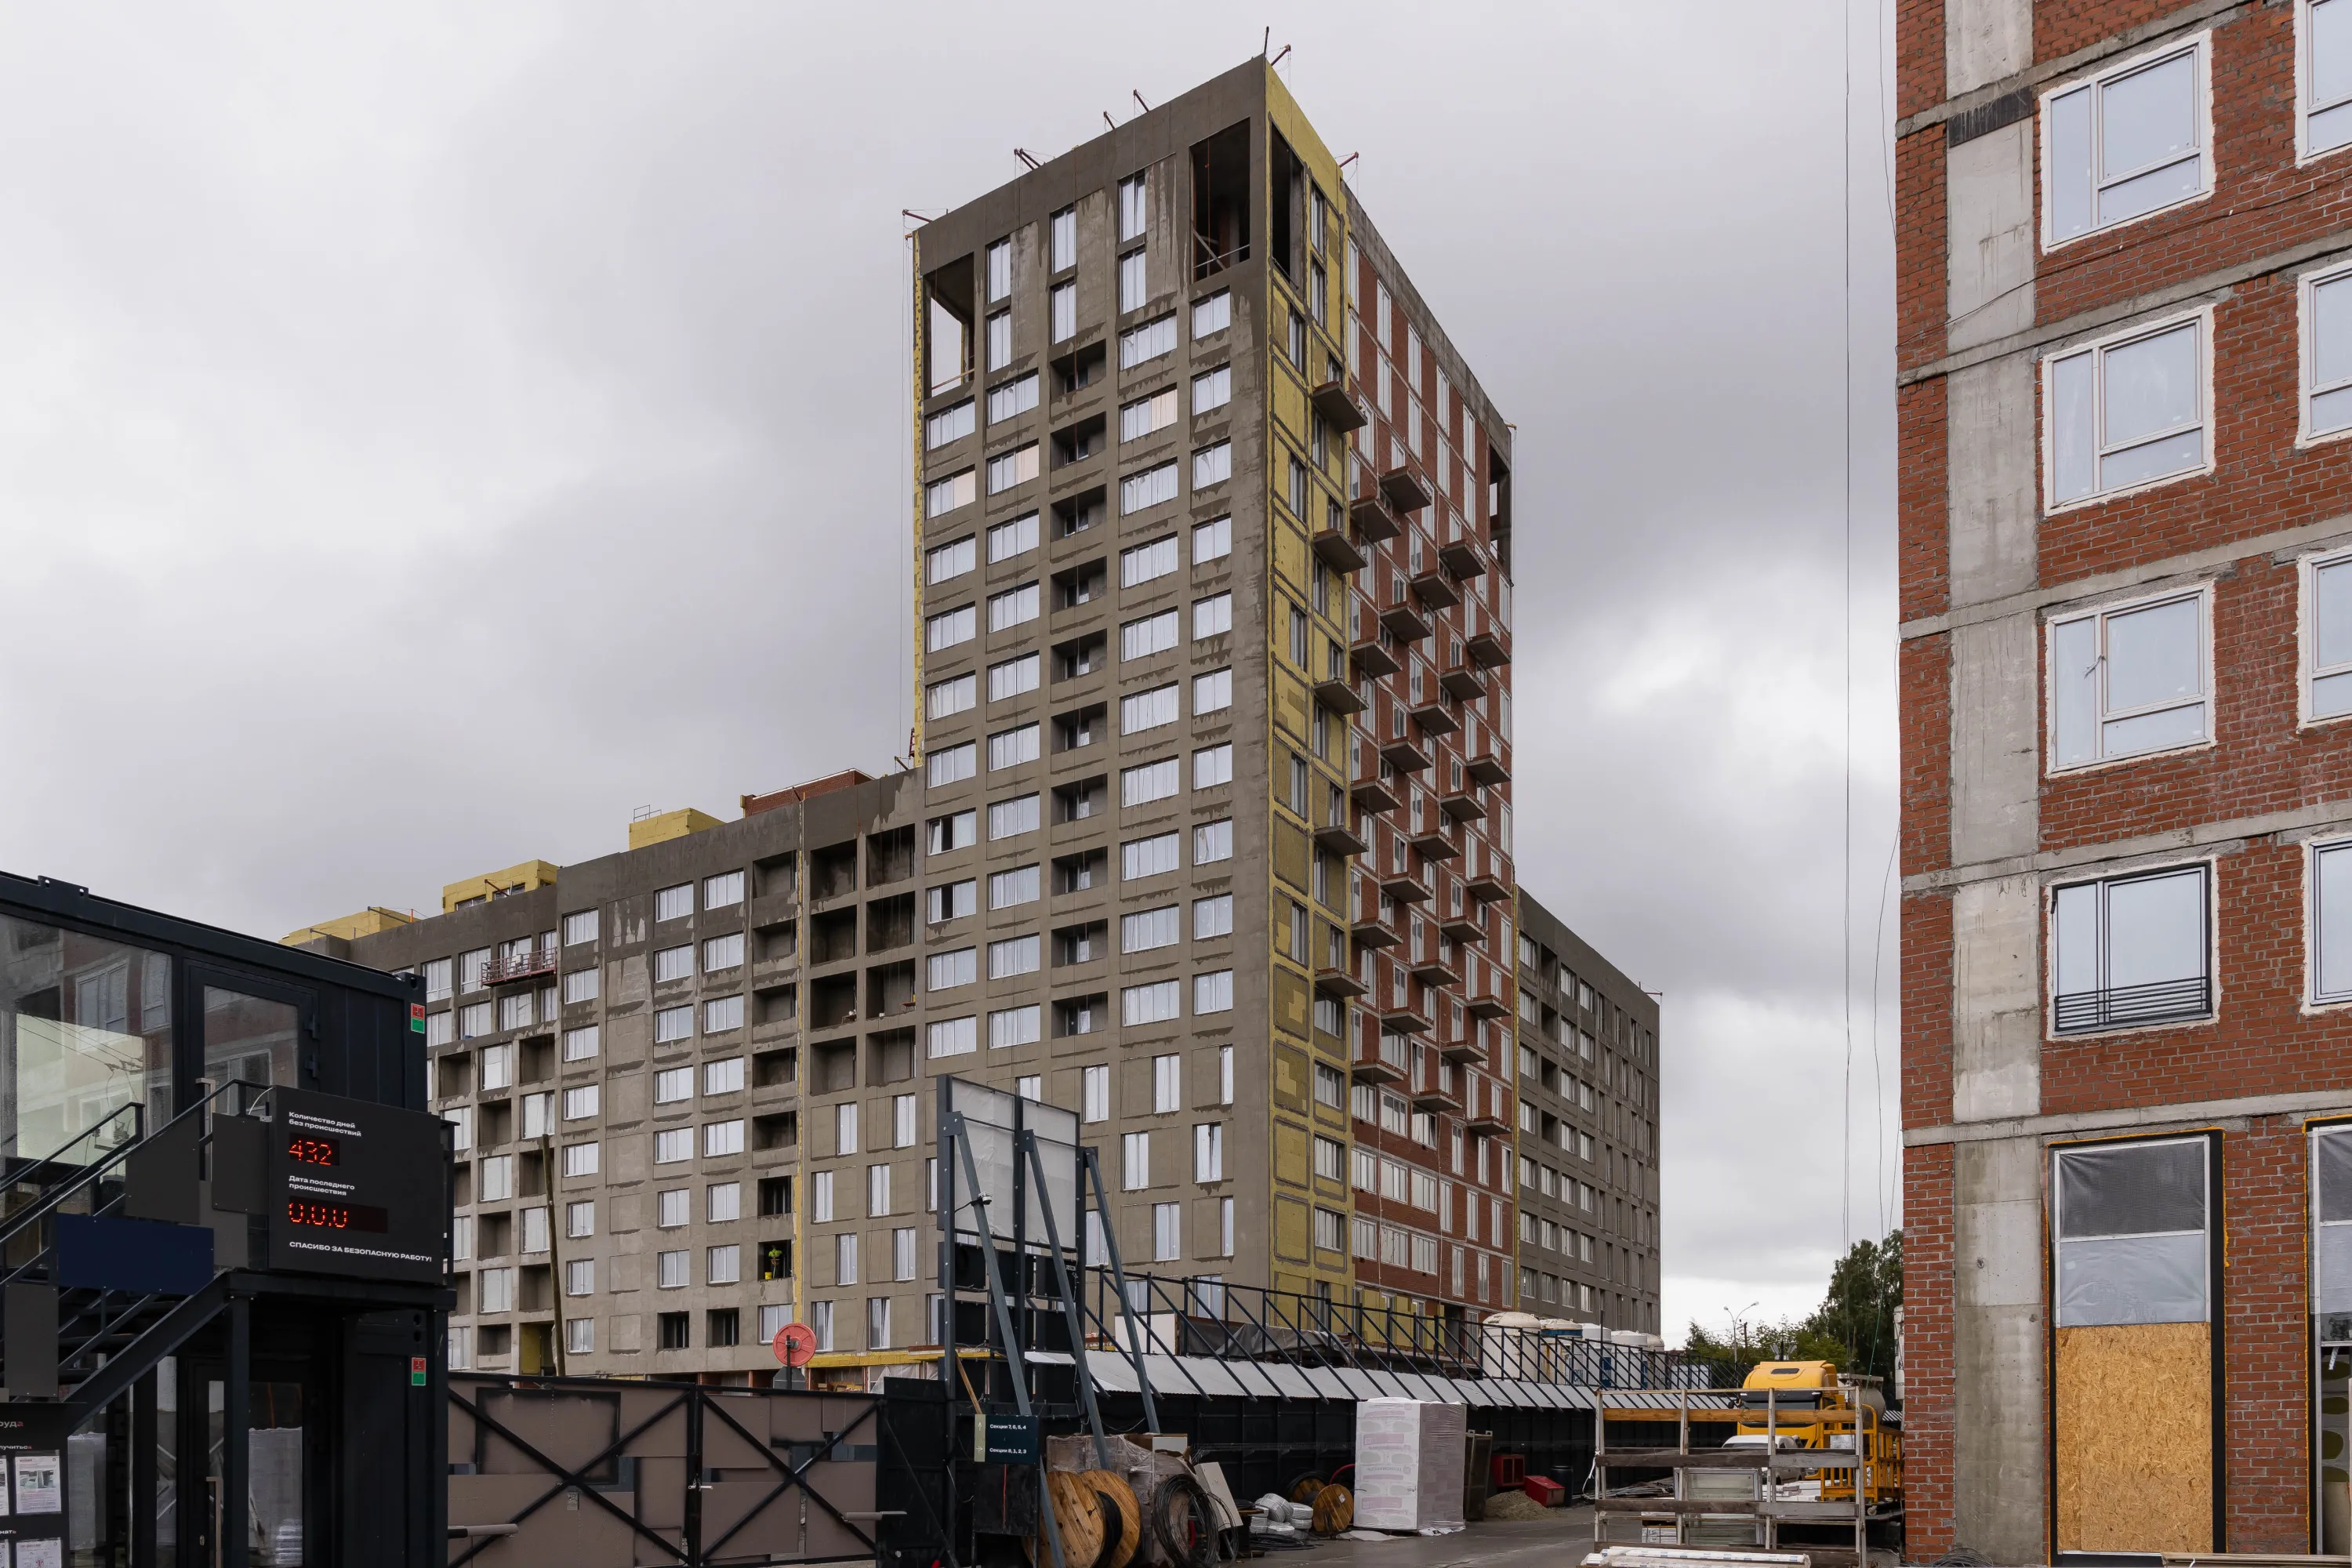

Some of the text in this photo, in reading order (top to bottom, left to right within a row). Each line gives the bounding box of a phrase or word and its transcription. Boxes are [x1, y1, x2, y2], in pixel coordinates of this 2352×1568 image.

[289, 1112, 354, 1129] Количество дней
[305, 1123, 361, 1137] происшествий
[289, 1140, 332, 1165] 432
[289, 1175, 354, 1190] Дата последнего
[289, 1184, 347, 1196] происшествия
[289, 1242, 330, 1251] СПАСИБО
[344, 1247, 399, 1258] БЕЗОПАСНУЮ
[401, 1254, 431, 1262] РАБОТУ!
